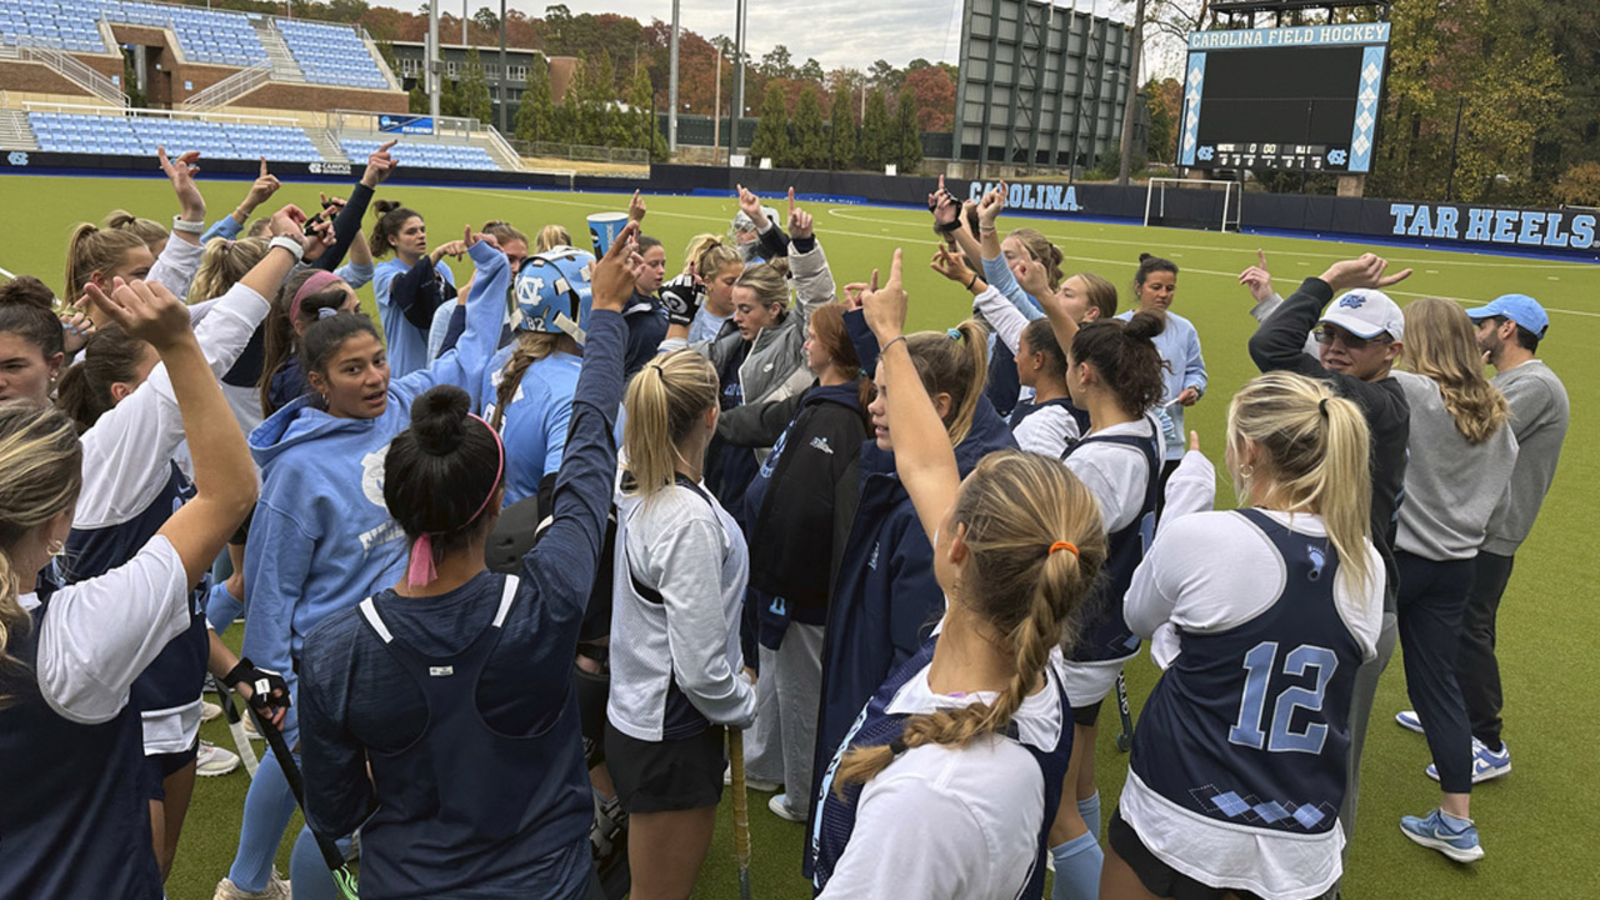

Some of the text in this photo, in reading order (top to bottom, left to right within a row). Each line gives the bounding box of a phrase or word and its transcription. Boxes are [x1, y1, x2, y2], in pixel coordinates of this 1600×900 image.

[1192, 25, 1387, 48] CAROLINA FIELD HOCKEY
[1390, 203, 1597, 249] TAR HEELS
[1227, 640, 1340, 755] 12
